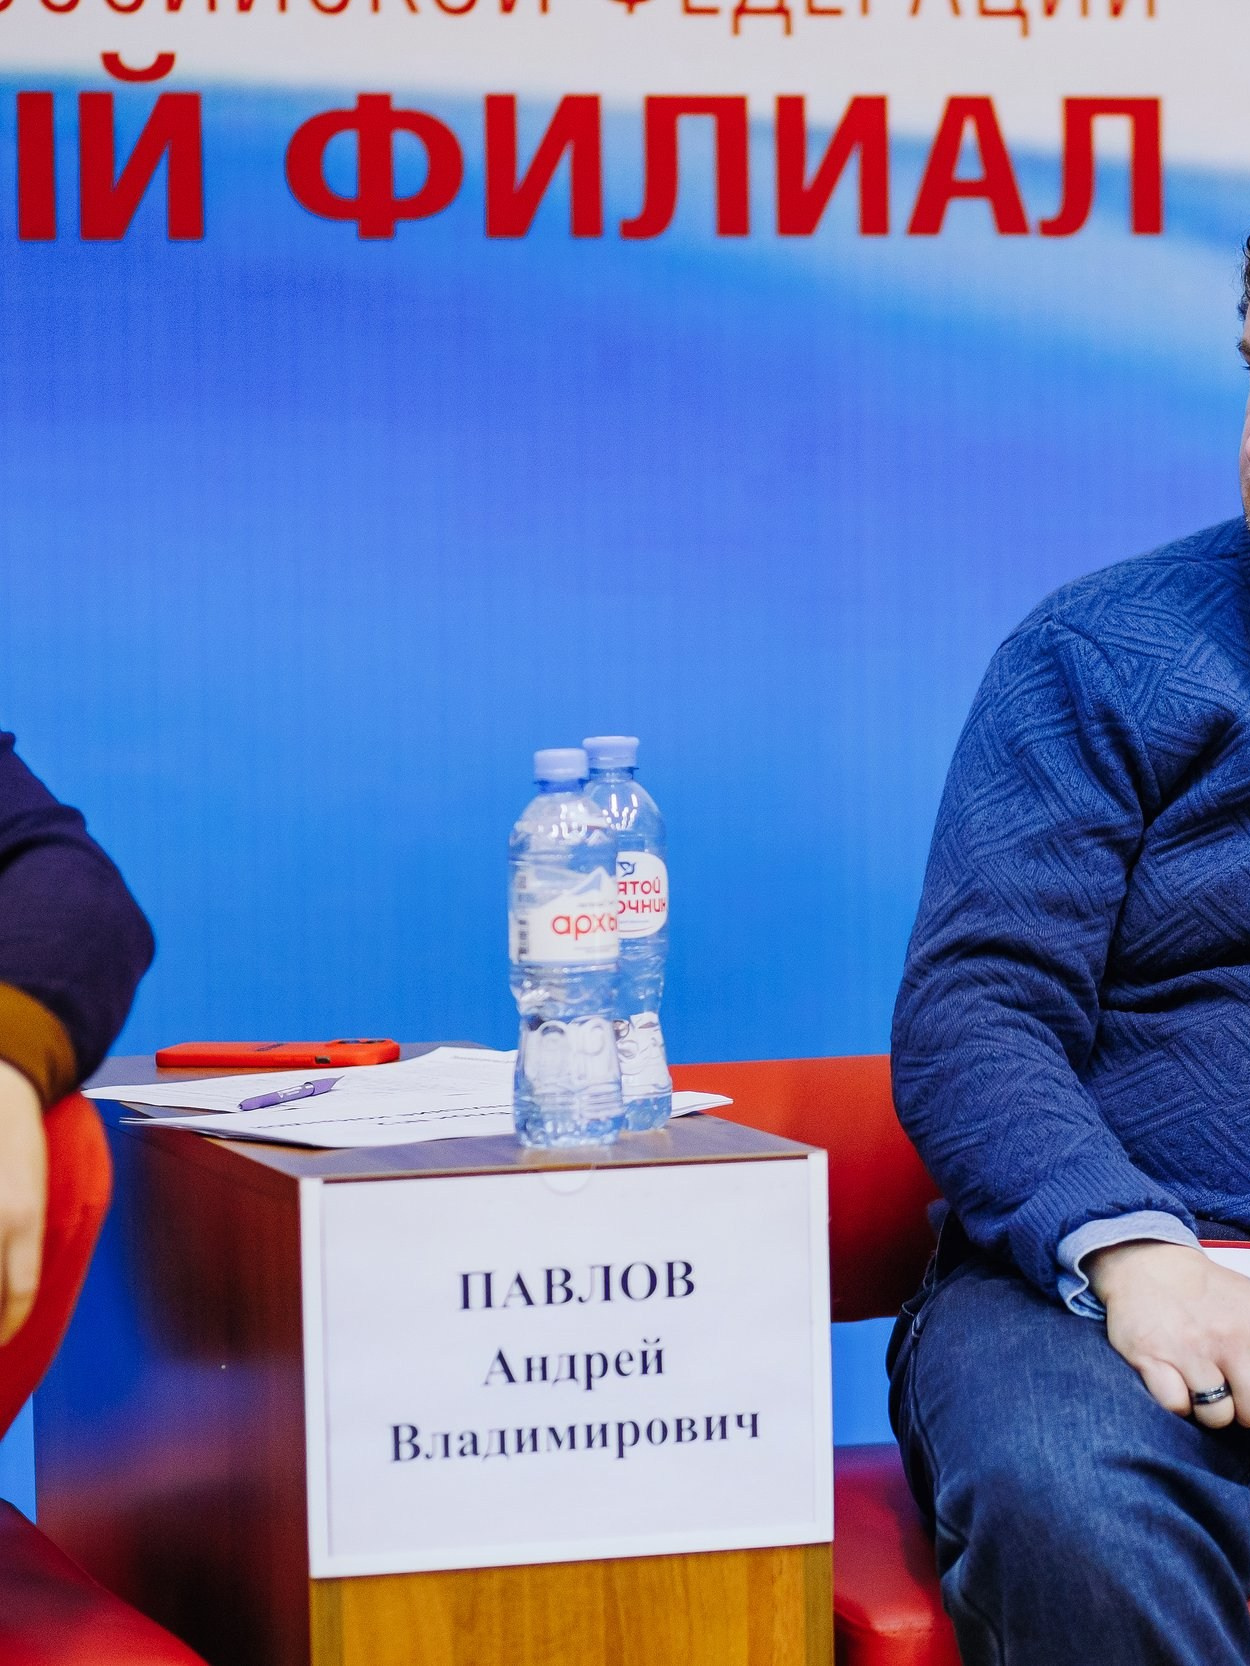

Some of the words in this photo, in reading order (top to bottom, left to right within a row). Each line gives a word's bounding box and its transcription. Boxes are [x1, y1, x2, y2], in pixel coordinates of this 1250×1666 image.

[285, 92, 1162, 240] ФИЛИАЛ
[458, 1259, 697, 1310] ПАВЛОВ
[482, 1337, 665, 1391] Андрей
[391, 1412, 760, 1463] Владимирович
